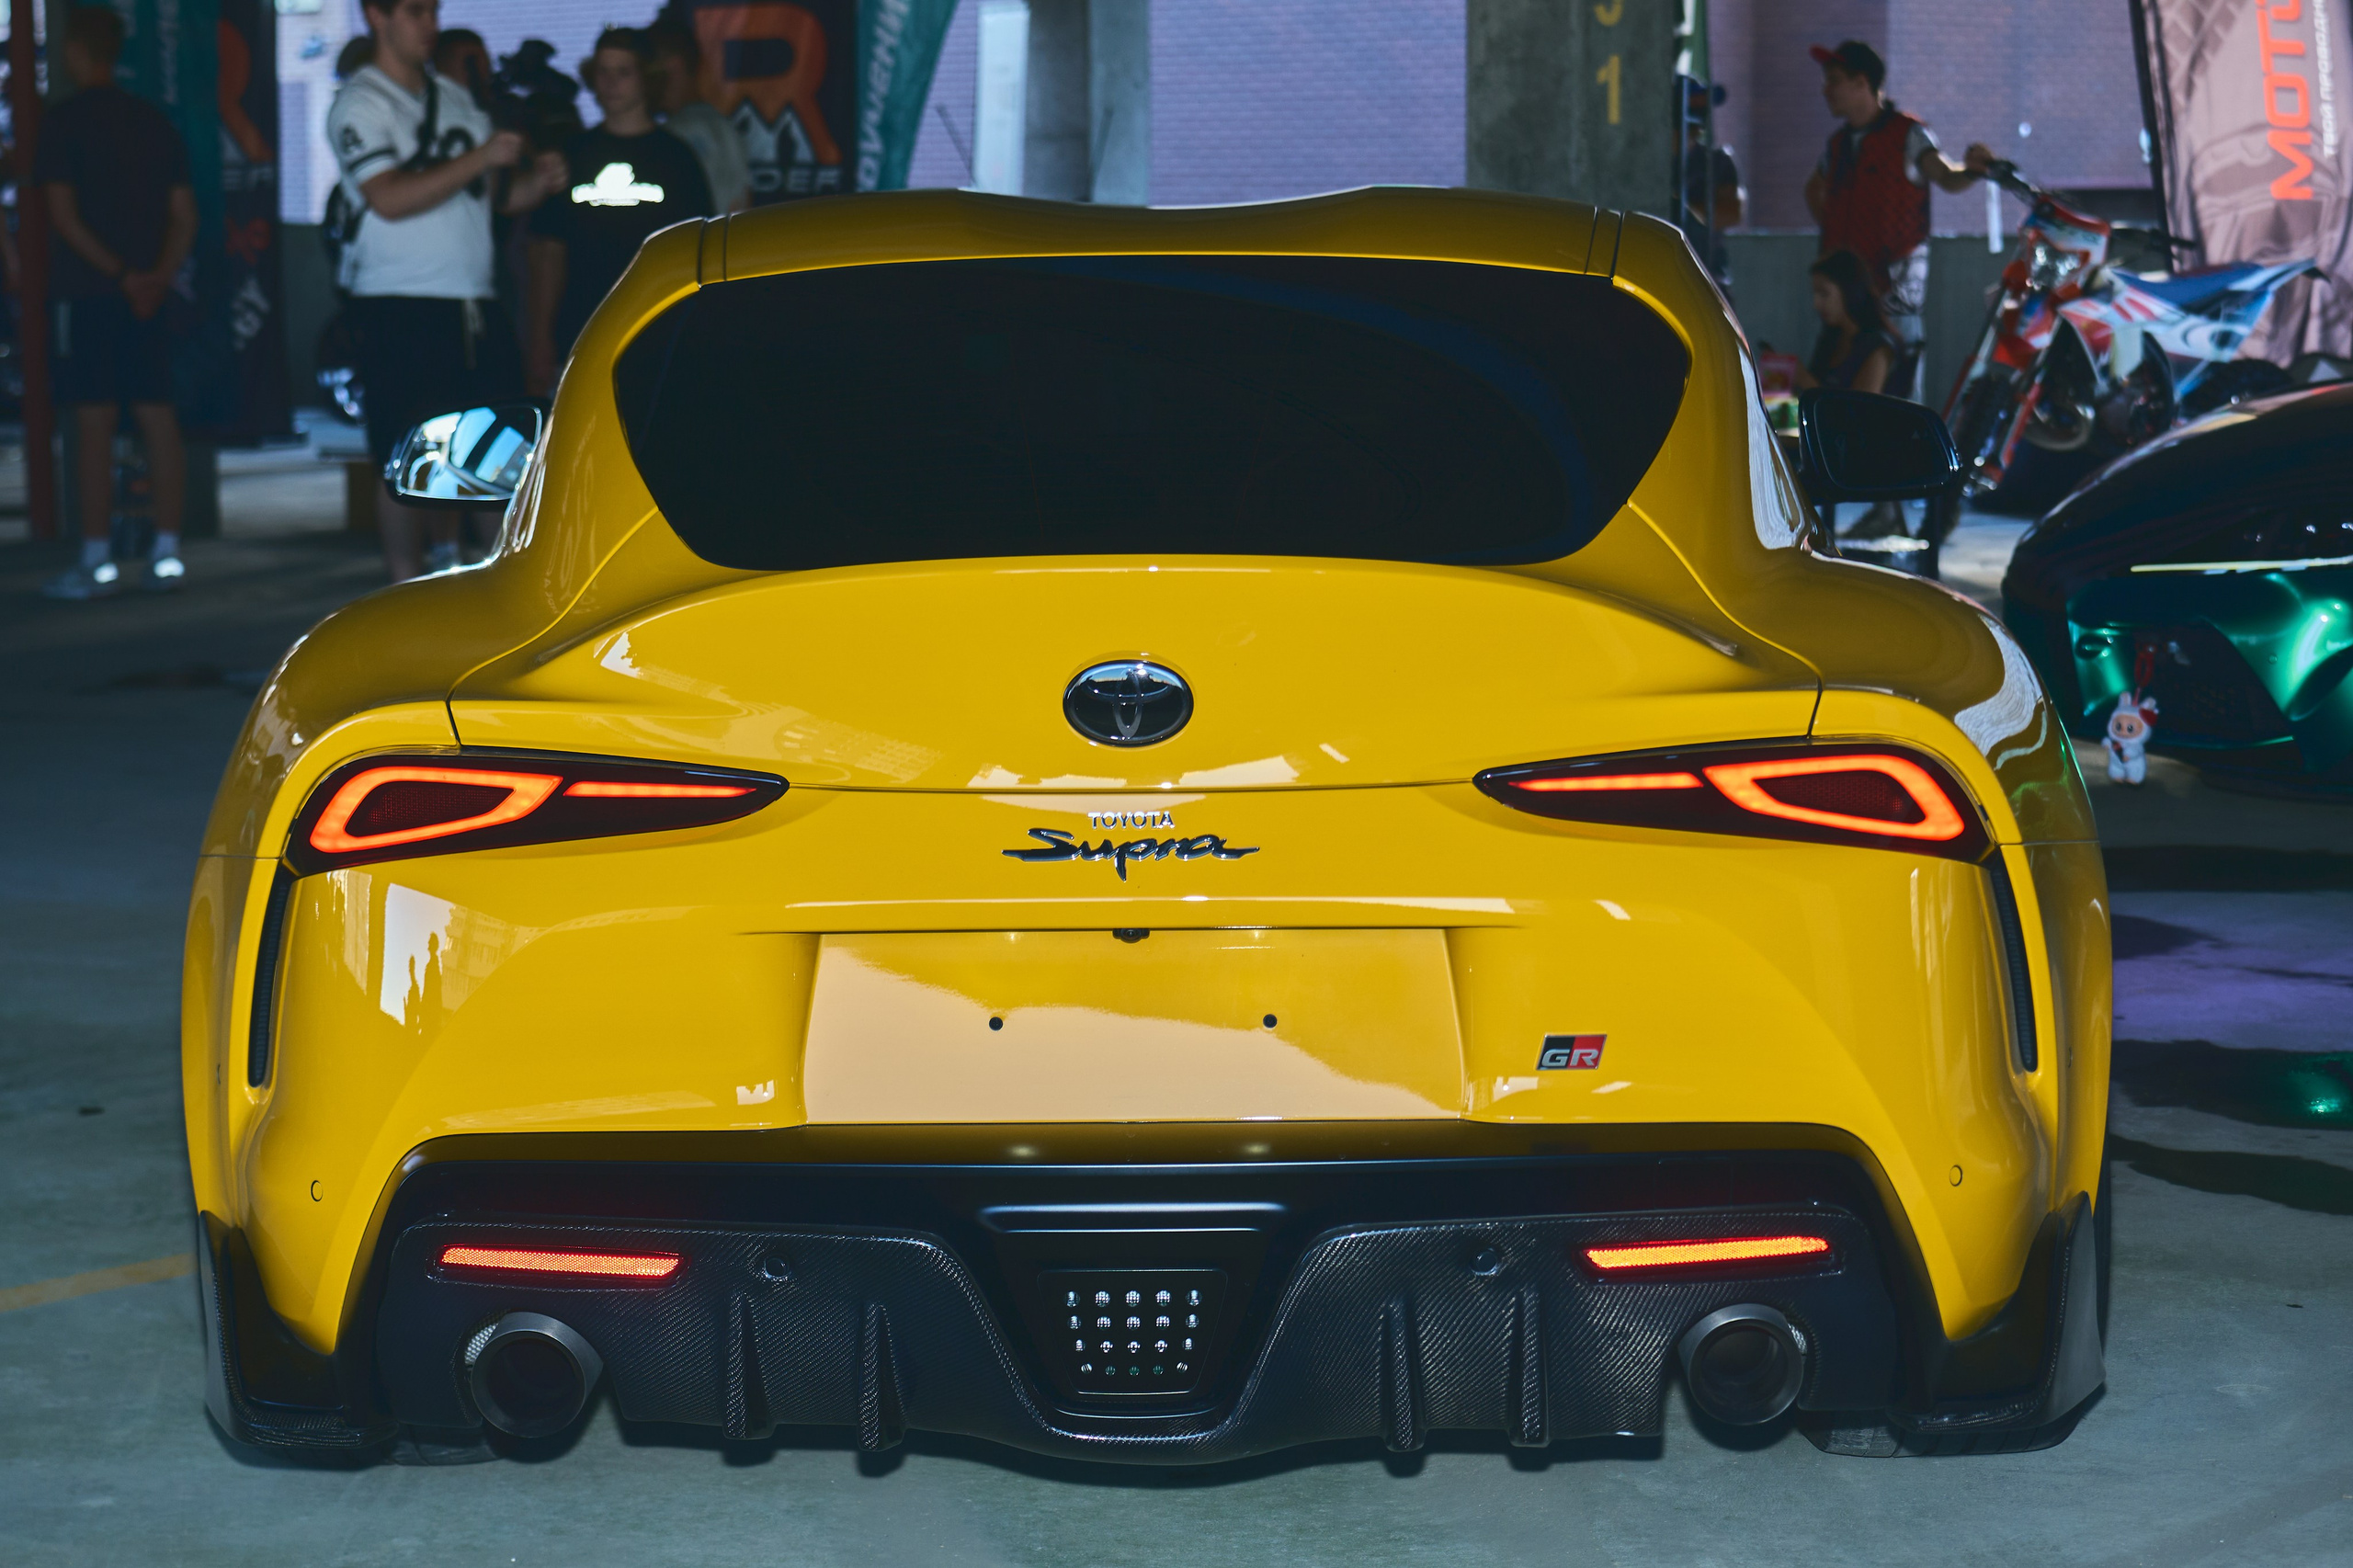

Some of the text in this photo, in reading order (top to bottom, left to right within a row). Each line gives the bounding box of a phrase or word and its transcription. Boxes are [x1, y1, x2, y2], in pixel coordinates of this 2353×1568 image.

[751, 167, 842, 193] DER
[1087, 811, 1176, 829] TOYOTA
[1001, 827, 1260, 882] Supra
[1541, 1049, 1599, 1067] GR
